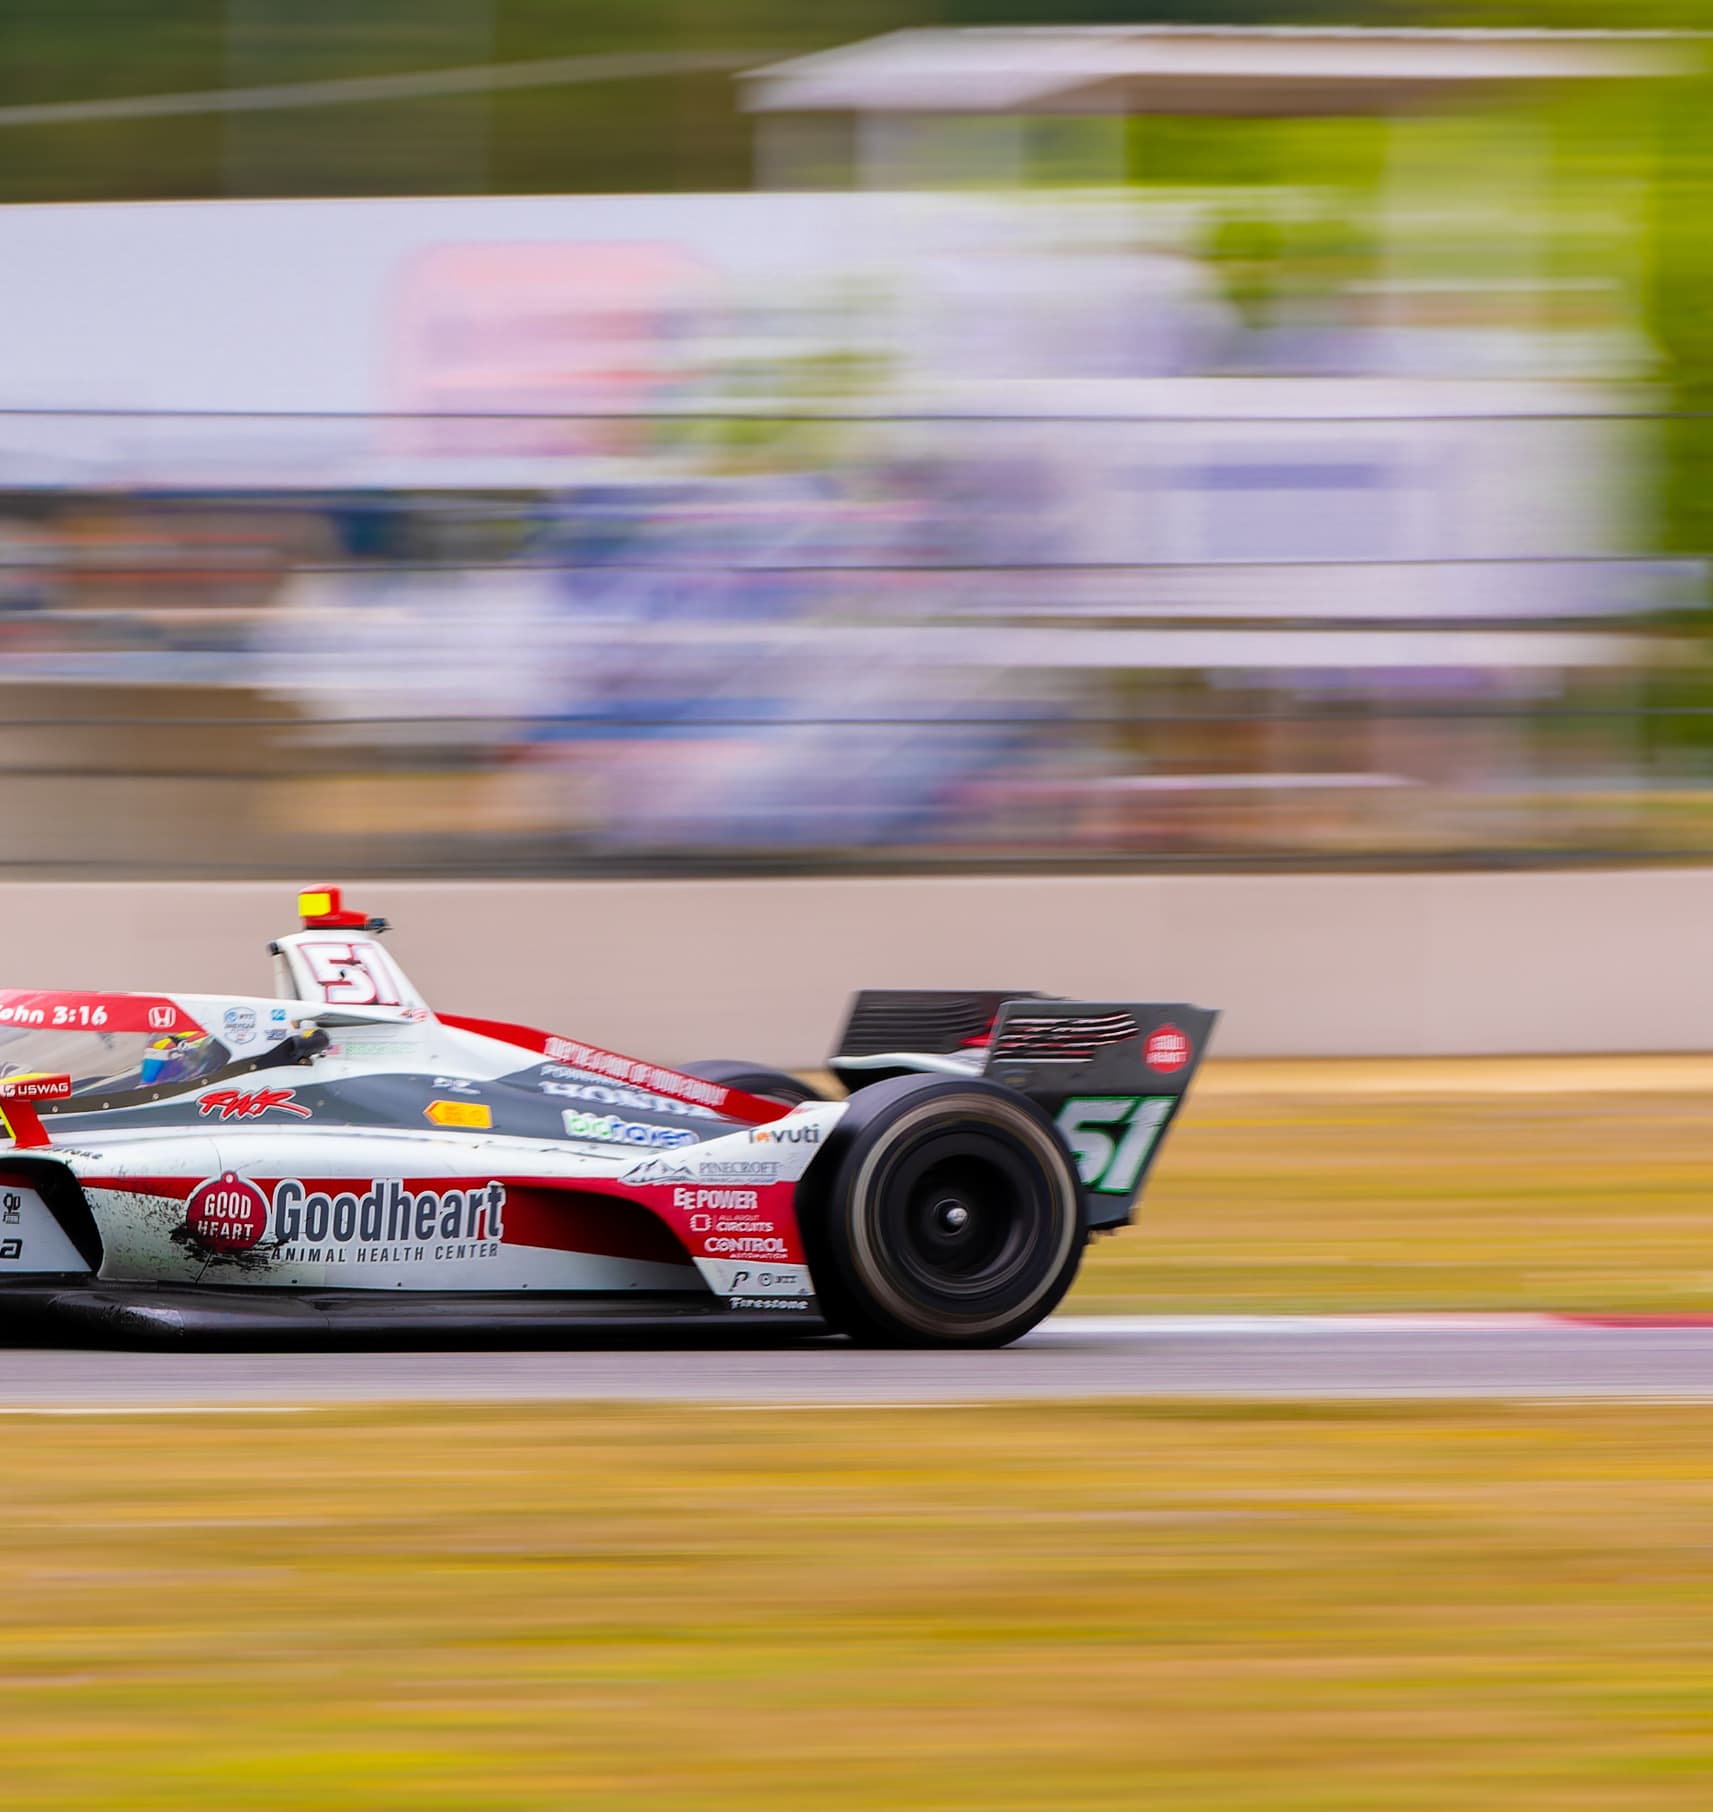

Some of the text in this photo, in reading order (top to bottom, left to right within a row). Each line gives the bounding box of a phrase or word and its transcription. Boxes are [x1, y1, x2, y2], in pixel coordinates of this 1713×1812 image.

[296, 943, 401, 1005] 51
[51, 1005, 108, 1026] 3:16
[18, 1082, 68, 1096] USWAG
[537, 1081, 730, 1121] HONDA
[1054, 1096, 1177, 1194] 51
[204, 1191, 251, 1219] GOOD
[272, 1178, 506, 1243] Goodheart
[197, 1222, 254, 1241] HEART
[716, 1222, 774, 1232] CIRCUITS
[270, 1243, 498, 1263] ANIMAL HEALTH CENTER
[704, 1237, 788, 1252] CONTROL
[729, 1297, 808, 1310] Firestone
